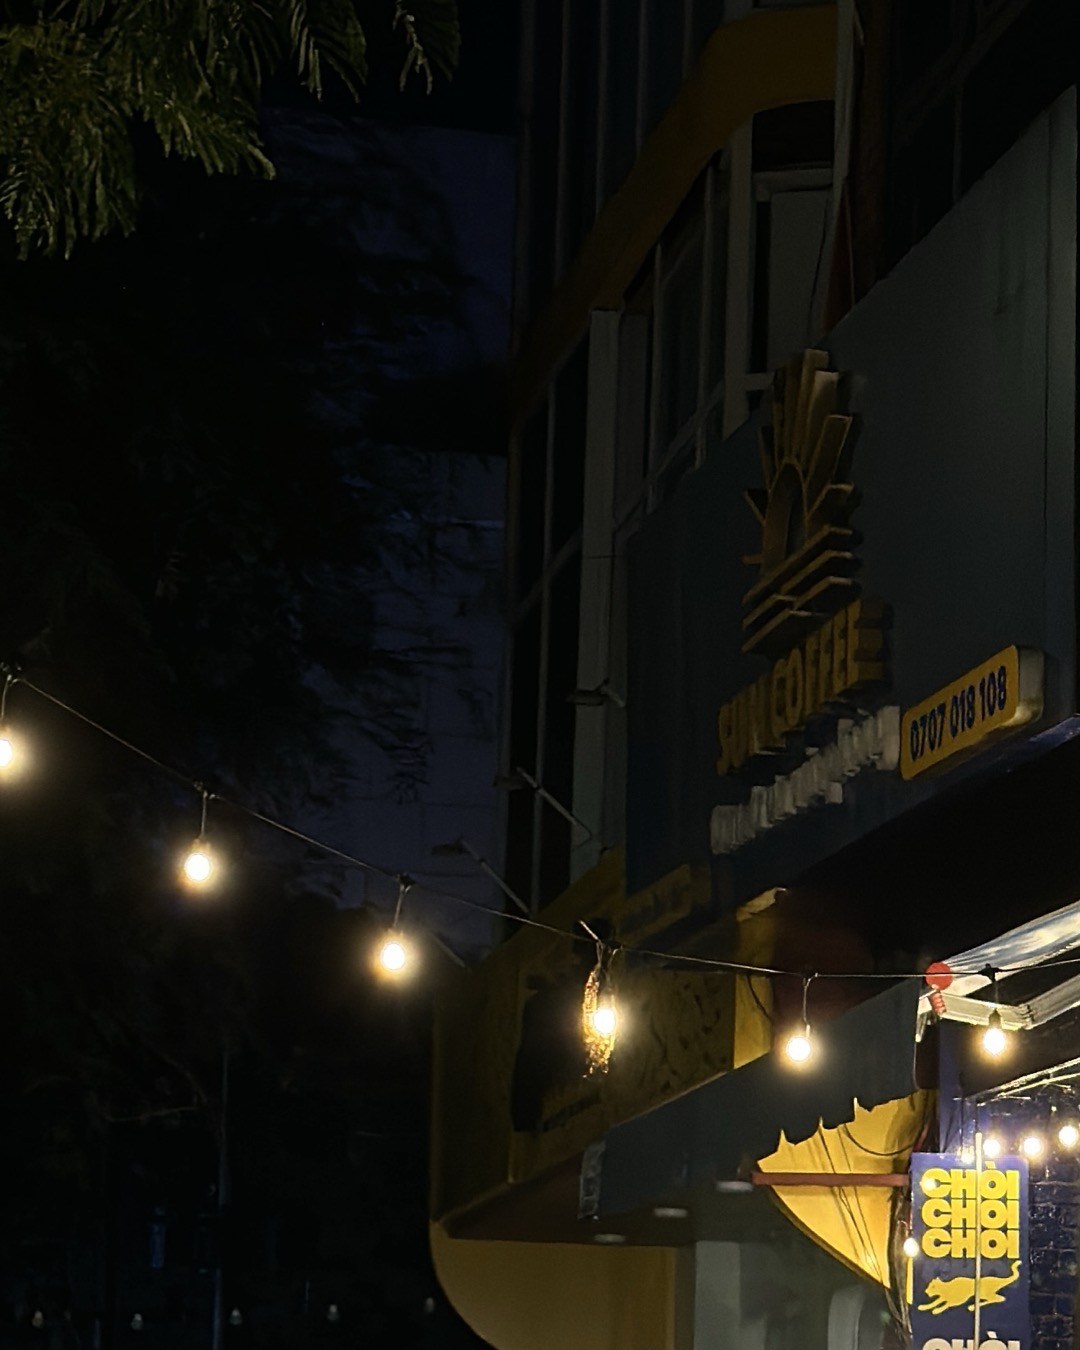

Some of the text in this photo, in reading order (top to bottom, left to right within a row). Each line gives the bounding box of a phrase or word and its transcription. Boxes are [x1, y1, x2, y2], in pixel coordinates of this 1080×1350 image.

[910, 666, 1006, 761] 0707 018 108
